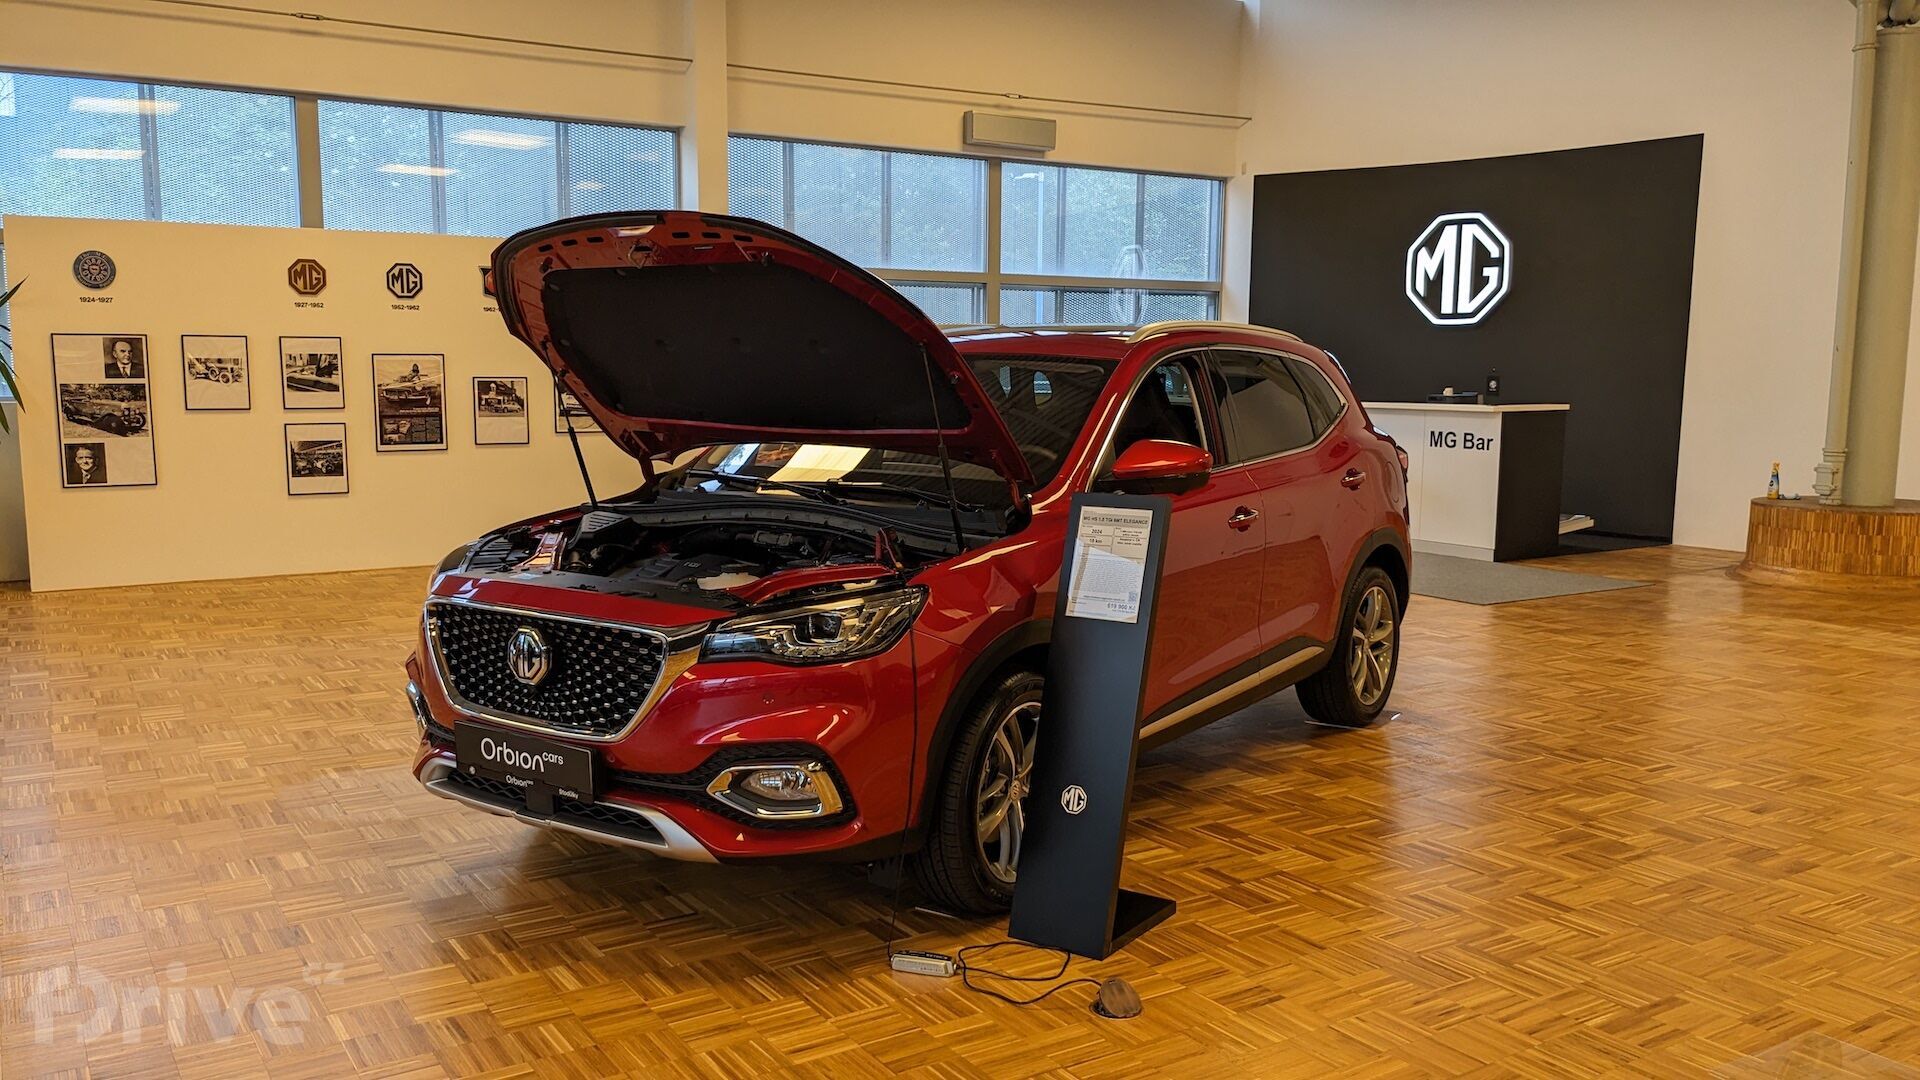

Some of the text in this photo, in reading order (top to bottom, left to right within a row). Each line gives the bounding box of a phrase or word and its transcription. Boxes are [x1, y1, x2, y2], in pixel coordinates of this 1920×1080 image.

[292, 263, 322, 291] MG
[390, 267, 418, 294] MG
[1415, 222, 1500, 314] MG
[1429, 430, 1494, 451] MG Bar
[509, 632, 541, 679] MG
[1063, 787, 1085, 812] MG
